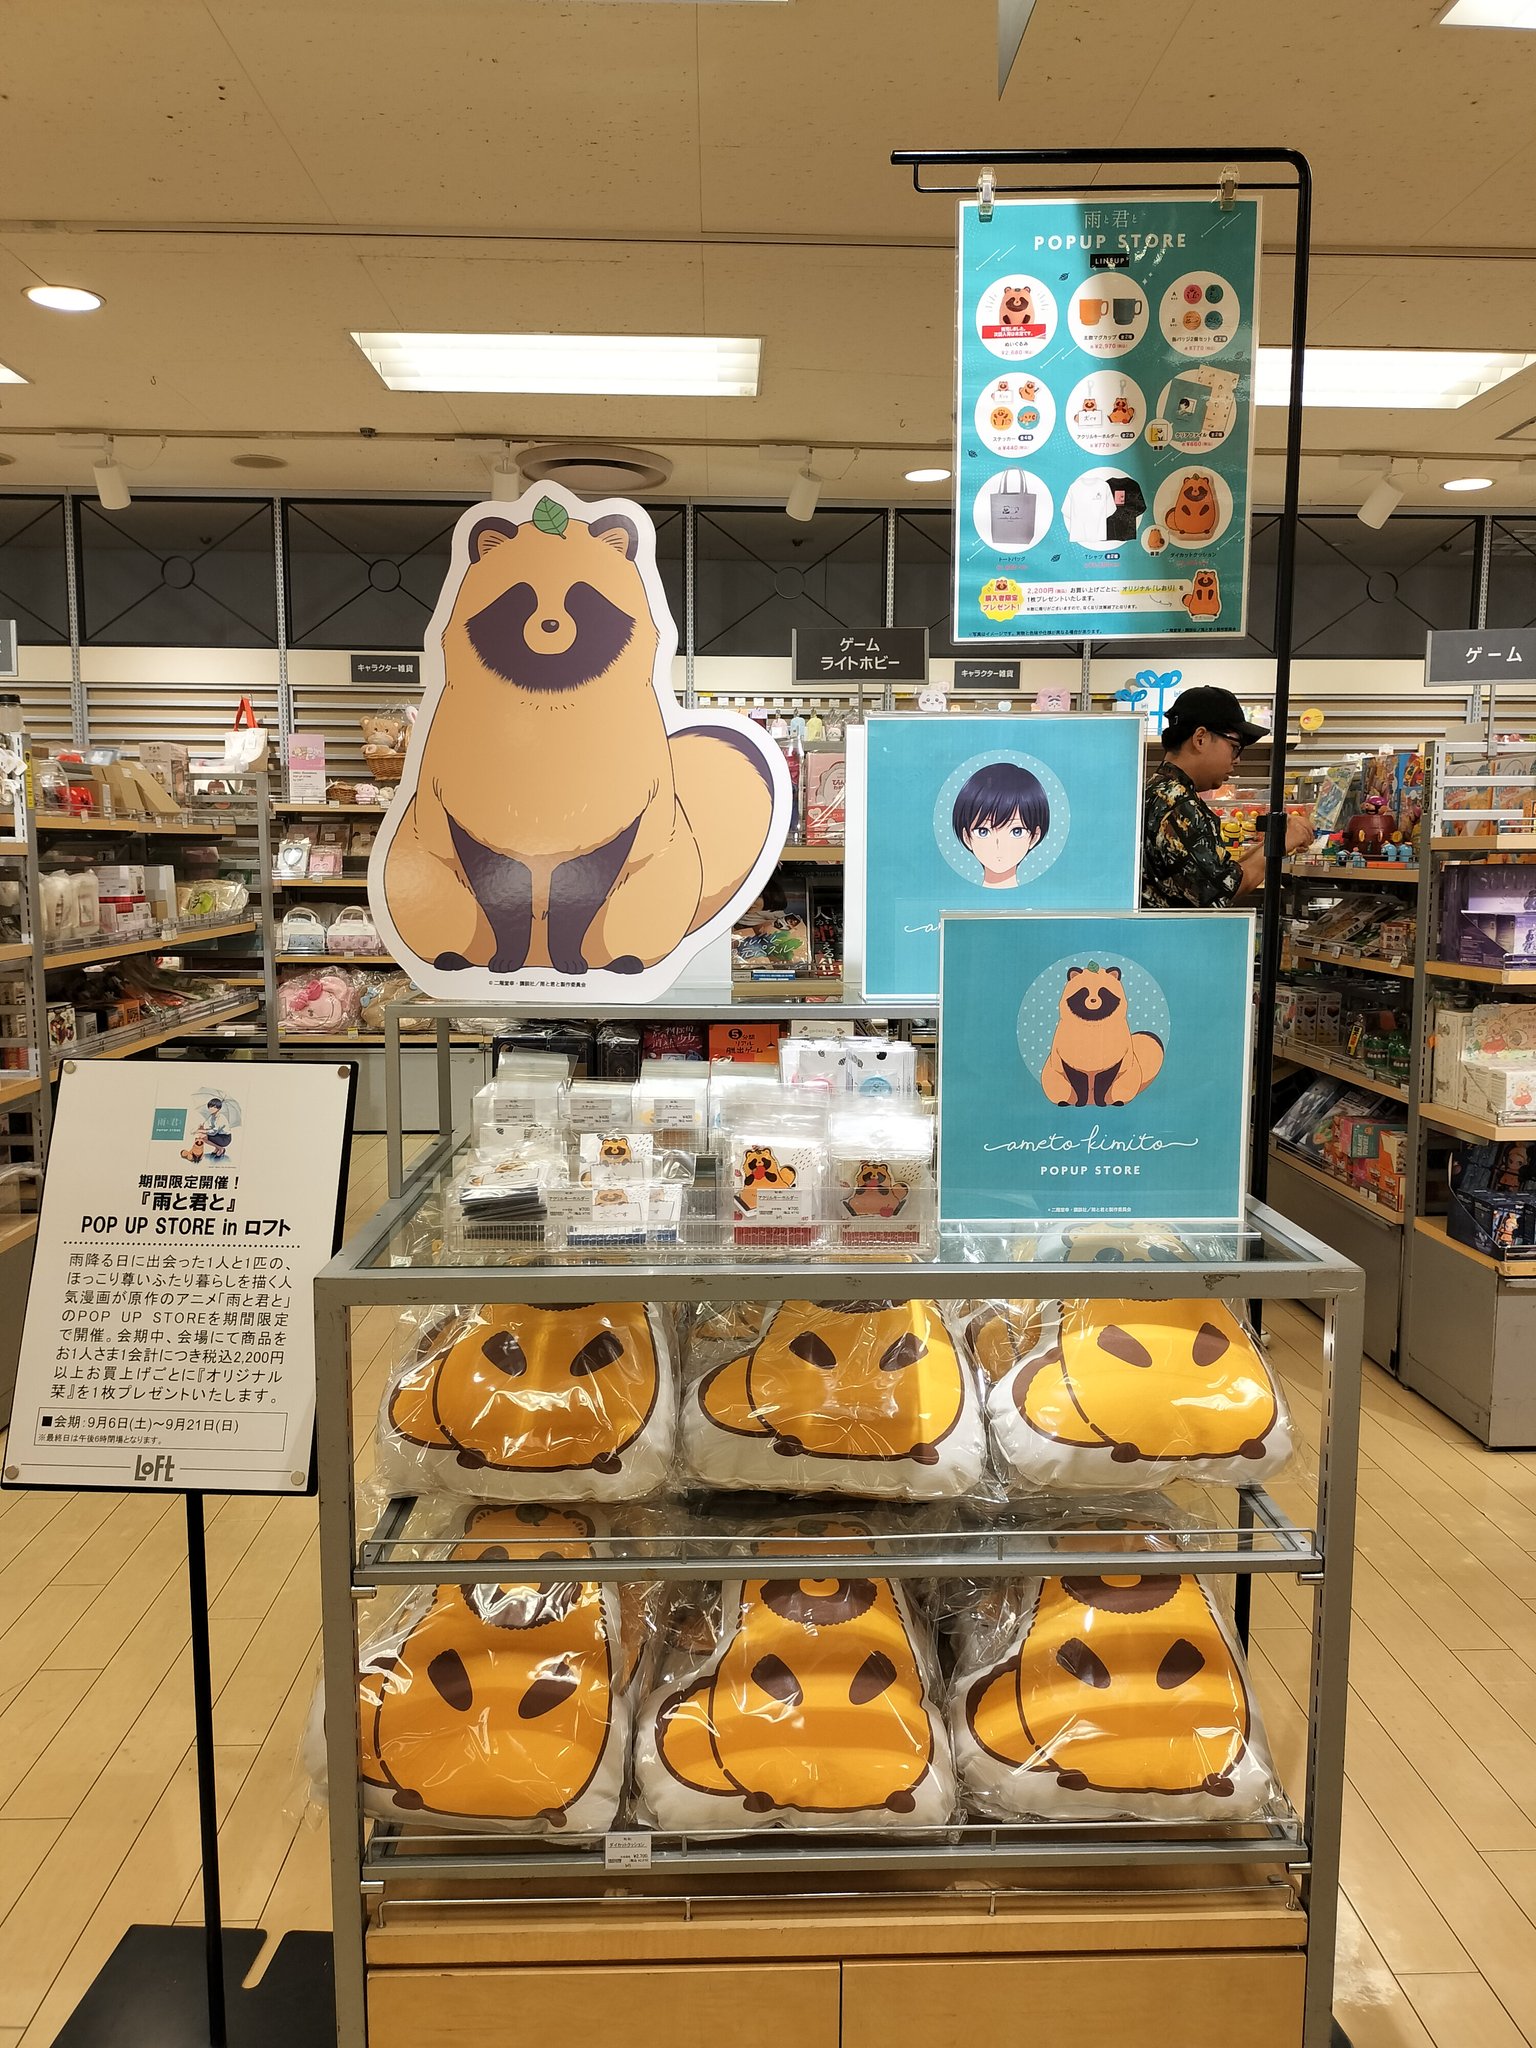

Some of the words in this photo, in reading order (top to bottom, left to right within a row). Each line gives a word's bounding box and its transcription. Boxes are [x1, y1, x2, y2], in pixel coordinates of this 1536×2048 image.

[1084, 209, 1137, 228] 雨と君と
[1034, 234, 1106, 250] POPUP
[1117, 233, 1186, 248] STORE
[1094, 257, 1125, 265] LINEUP
[839, 637, 880, 652] ゲーム
[820, 655, 900, 670] ライトホビー
[1465, 646, 1522, 664] ゲーム
[357, 664, 414, 673] キャラクター雑貨
[960, 669, 1014, 678] キャラクター雑貨
[983, 1133, 1080, 1151] ameto
[1081, 1124, 1198, 1154] kimito
[1040, 1165, 1088, 1176] POPUP
[1094, 1165, 1141, 1175] STORE
[138, 1173, 240, 1190] 期間限定開催！
[140, 1191, 236, 1213] 『雨と君と』
[81, 1216, 118, 1234] POP
[125, 1216, 149, 1234] UP
[155, 1217, 216, 1235] STORE
[222, 1218, 238, 1235] in
[244, 1218, 292, 1237] ロフト
[69, 1253, 292, 1271] 雨降る日に出会った1人と1匹の、
[67, 1271, 292, 1289] ほっこり尊いふたり暮らしを描く人
[64, 1290, 290, 1308] 気漫画が原作のアニメ「雨と君と」
[61, 1309, 110, 1323] のPOP
[121, 1310, 142, 1323] UP
[152, 1311, 288, 1327] STOREを期間限定
[59, 1328, 287, 1346] で開催。会期中、会場にて商品を
[55, 1346, 285, 1365] お1人さま1会計につき税込2,200円
[53, 1366, 282, 1384] 以上お買上げごとに『オリジナル
[50, 1384, 278, 1403] 栞』を1枚プレゼントいたします。
